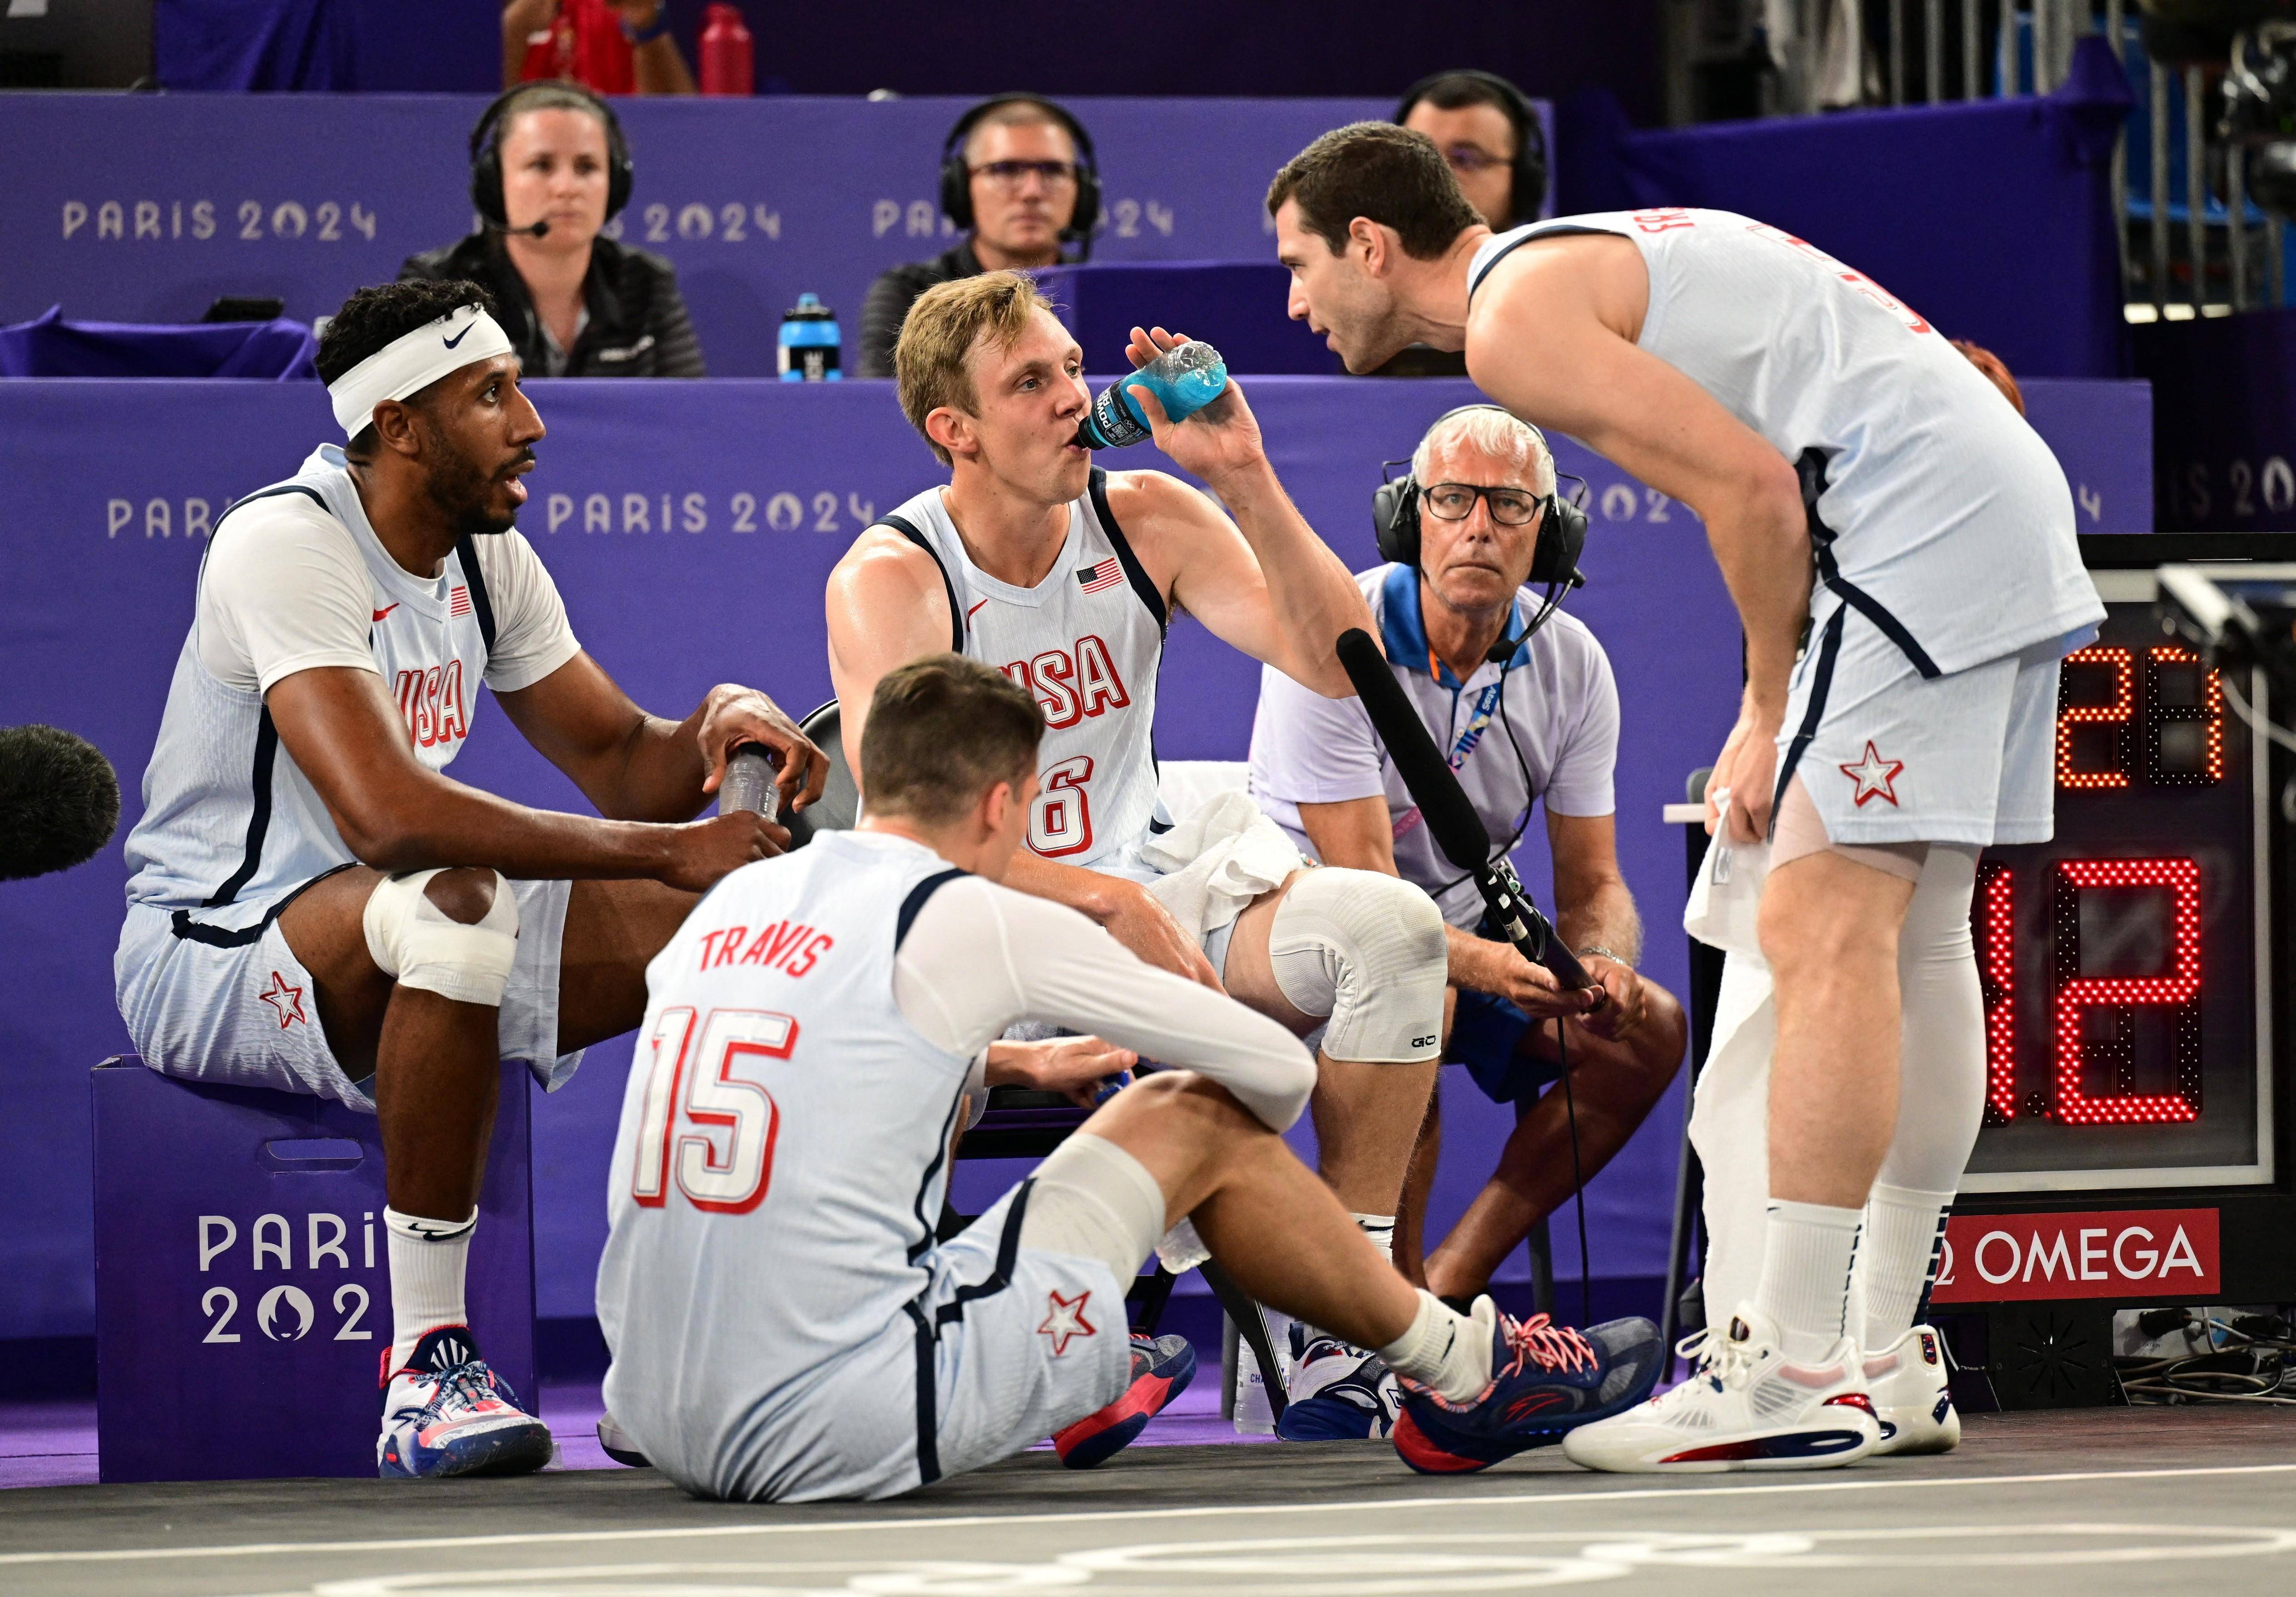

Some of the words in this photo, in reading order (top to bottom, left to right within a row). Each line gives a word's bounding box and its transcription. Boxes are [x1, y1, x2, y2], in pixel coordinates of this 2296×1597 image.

[237, 200, 376, 241] 2024
[644, 203, 781, 242] 2024
[730, 491, 875, 533] 2024
[393, 659, 467, 747] USA
[2057, 647, 2222, 788] 27
[1026, 756, 1094, 857] 6
[699, 920, 834, 978] TRAVIS
[633, 1006, 800, 1216] 15
[1974, 1223, 2204, 1285] OMEGA
